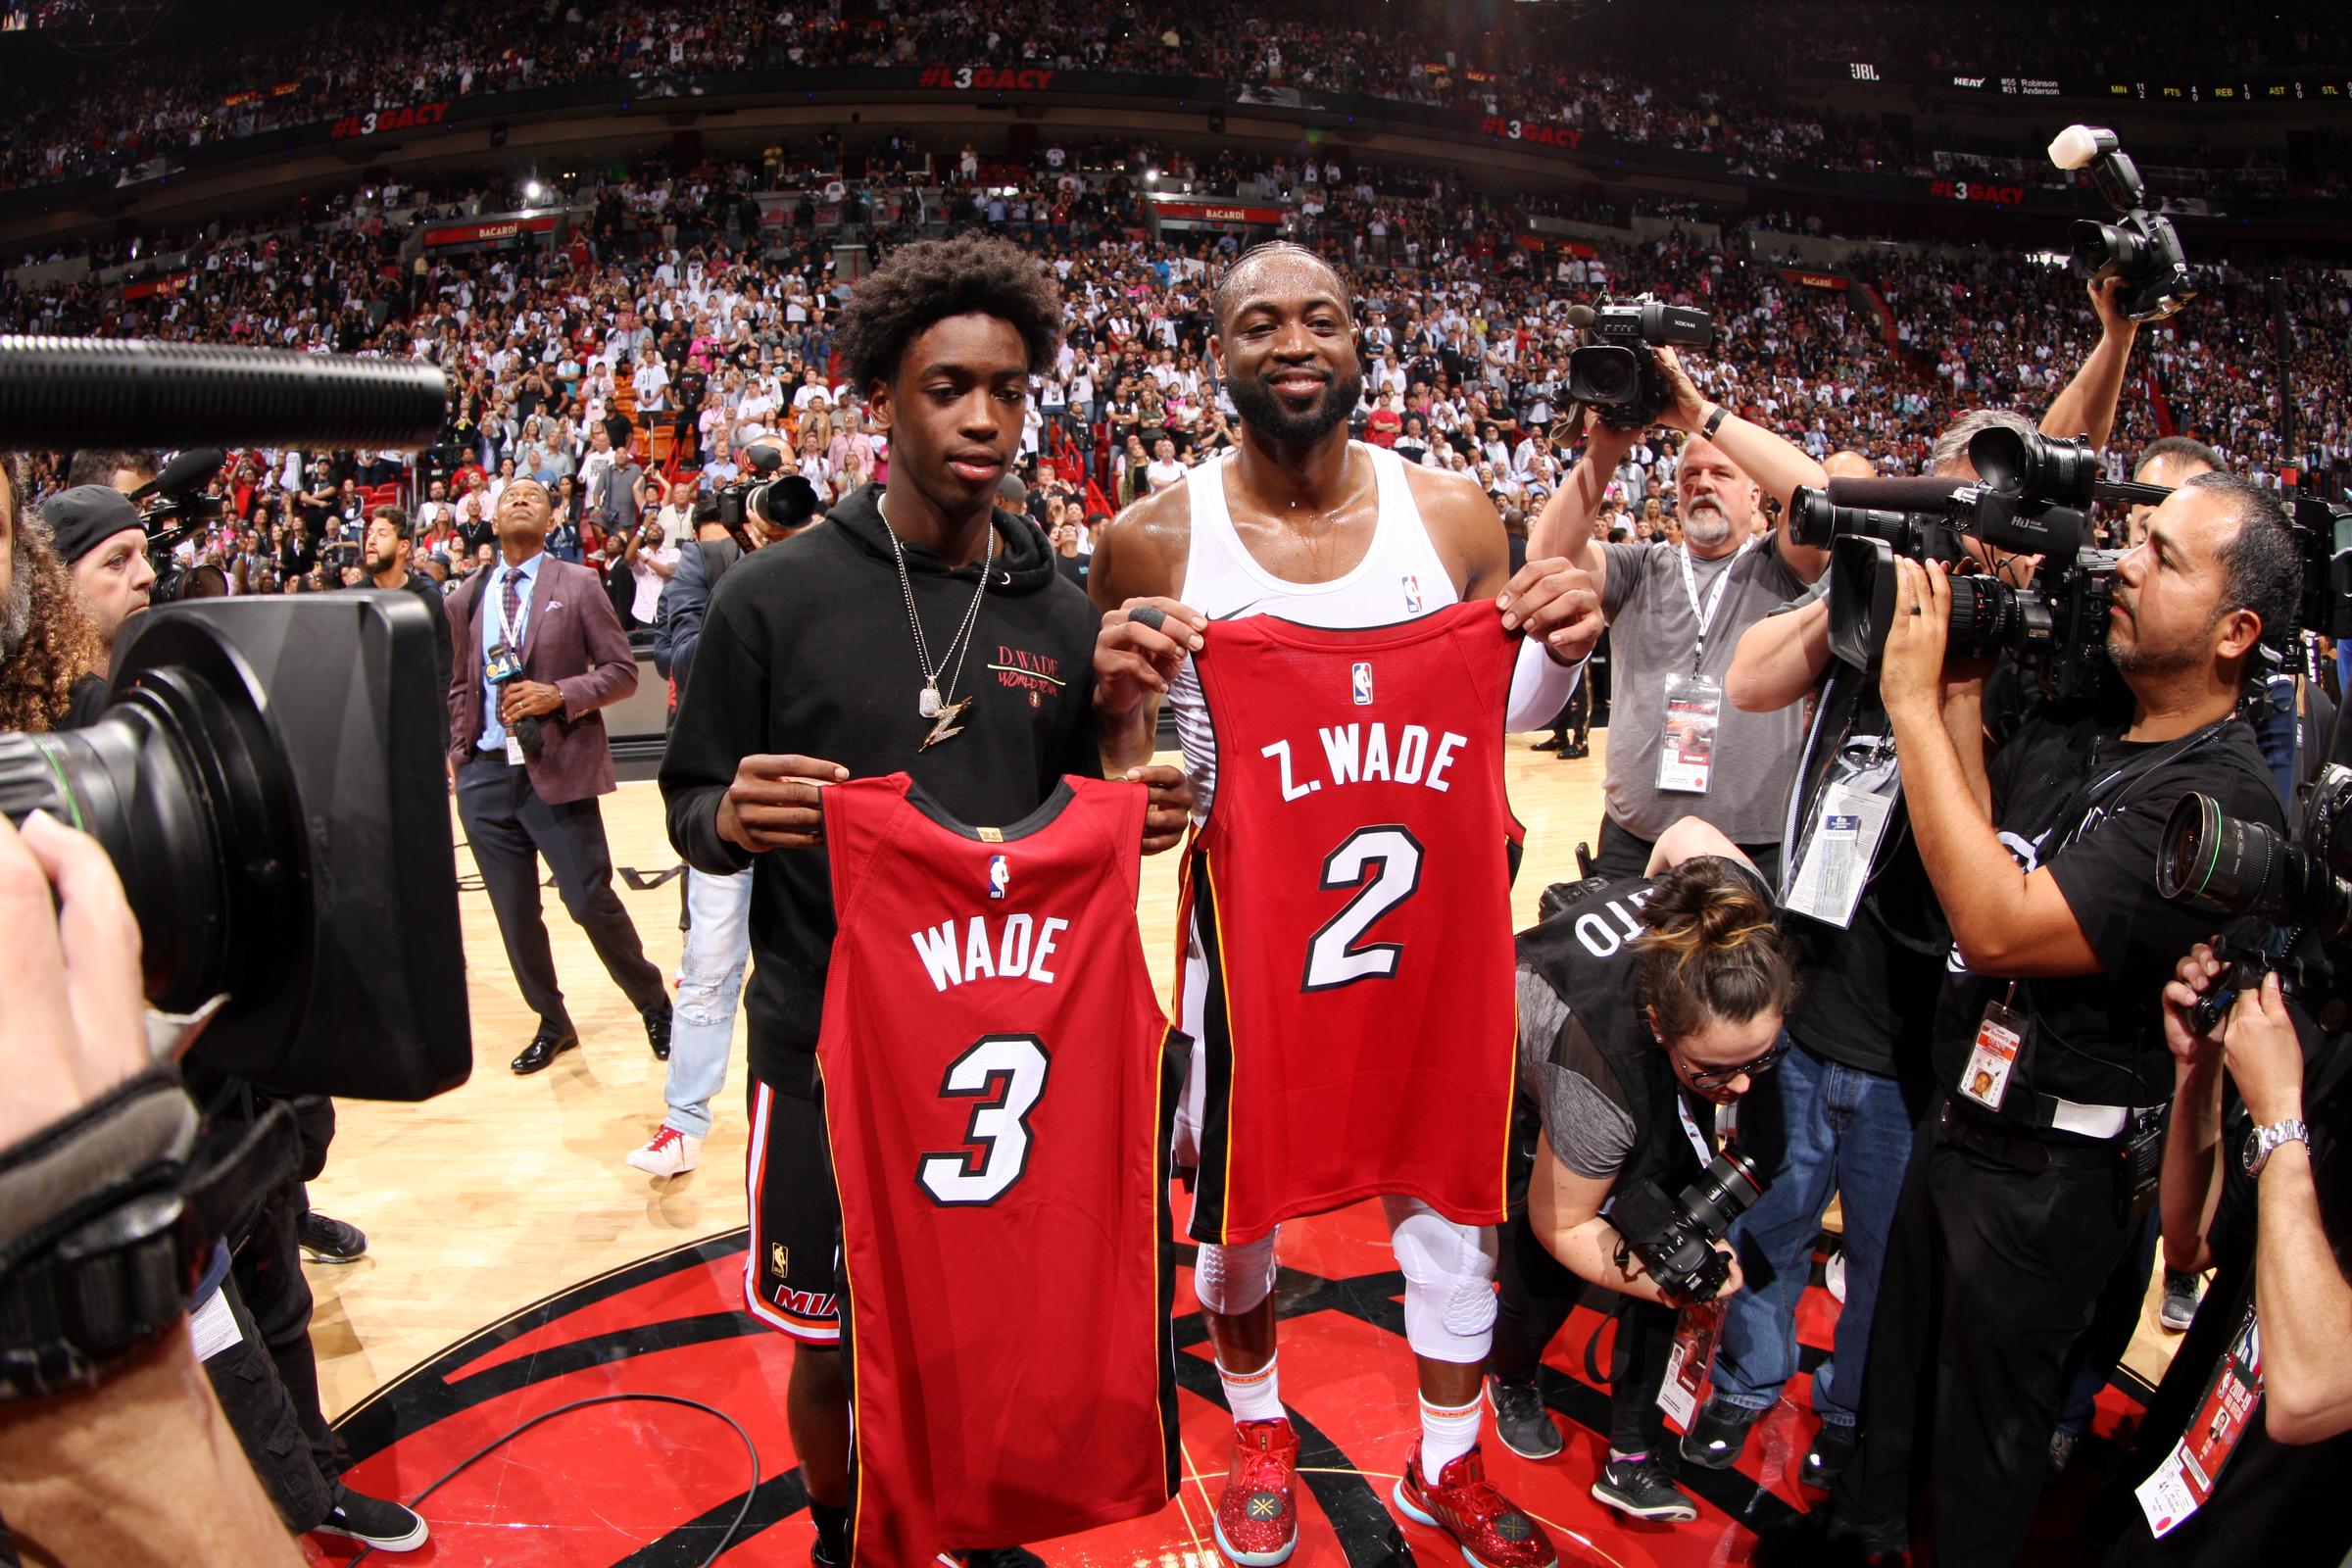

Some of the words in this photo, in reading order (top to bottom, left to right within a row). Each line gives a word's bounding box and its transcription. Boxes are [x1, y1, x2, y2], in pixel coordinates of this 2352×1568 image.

[919, 68, 1058, 90] #L3GACY
[1850, 63, 1880, 80] JBL
[1954, 76, 1985, 87] HEAT
[2021, 78, 2059, 88] Robinson
[2111, 85, 2128, 95] MIN
[2022, 86, 2060, 95] Anderson
[2164, 88, 2181, 98] PTS
[2215, 88, 2234, 97] REB
[2269, 86, 2285, 95] AST
[2322, 86, 2339, 95] STL
[330, 101, 452, 139] #L3GACY
[1481, 116, 1585, 150] #L3GACY
[1929, 179, 2025, 205] #L3GACY
[497, 657, 511, 674] 4
[998, 671, 1038, 688] WORLD
[1261, 722, 1468, 803] Z.WADE
[1300, 824, 1426, 994] 2
[910, 911, 1069, 992] WADE
[915, 1033, 1052, 1208] 3
